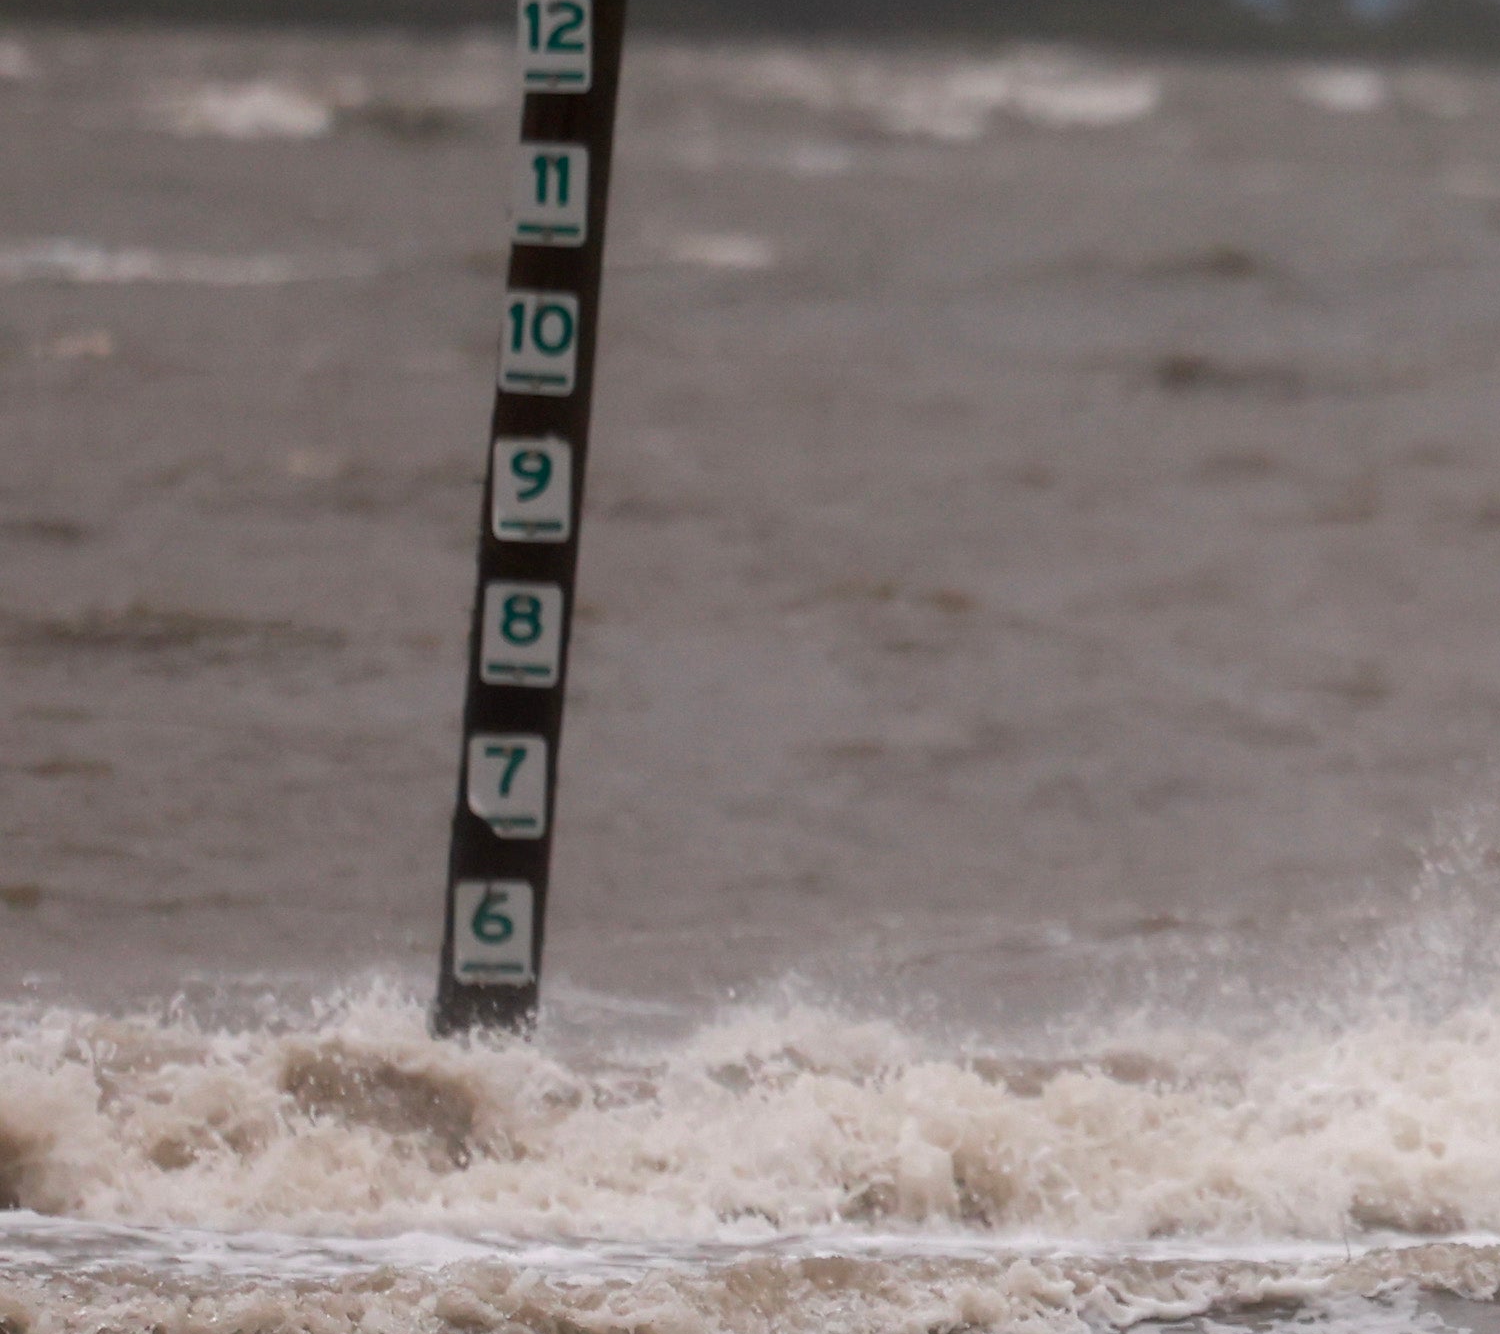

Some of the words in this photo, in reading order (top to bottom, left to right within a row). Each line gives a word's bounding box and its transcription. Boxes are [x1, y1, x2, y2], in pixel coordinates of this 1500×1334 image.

[524, 0, 585, 54] 12
[532, 155, 570, 207] 11
[509, 302, 574, 357] 10
[511, 450, 554, 502] 9
[501, 594, 543, 646] 8
[484, 747, 527, 797] 7
[471, 889, 514, 943] 6
